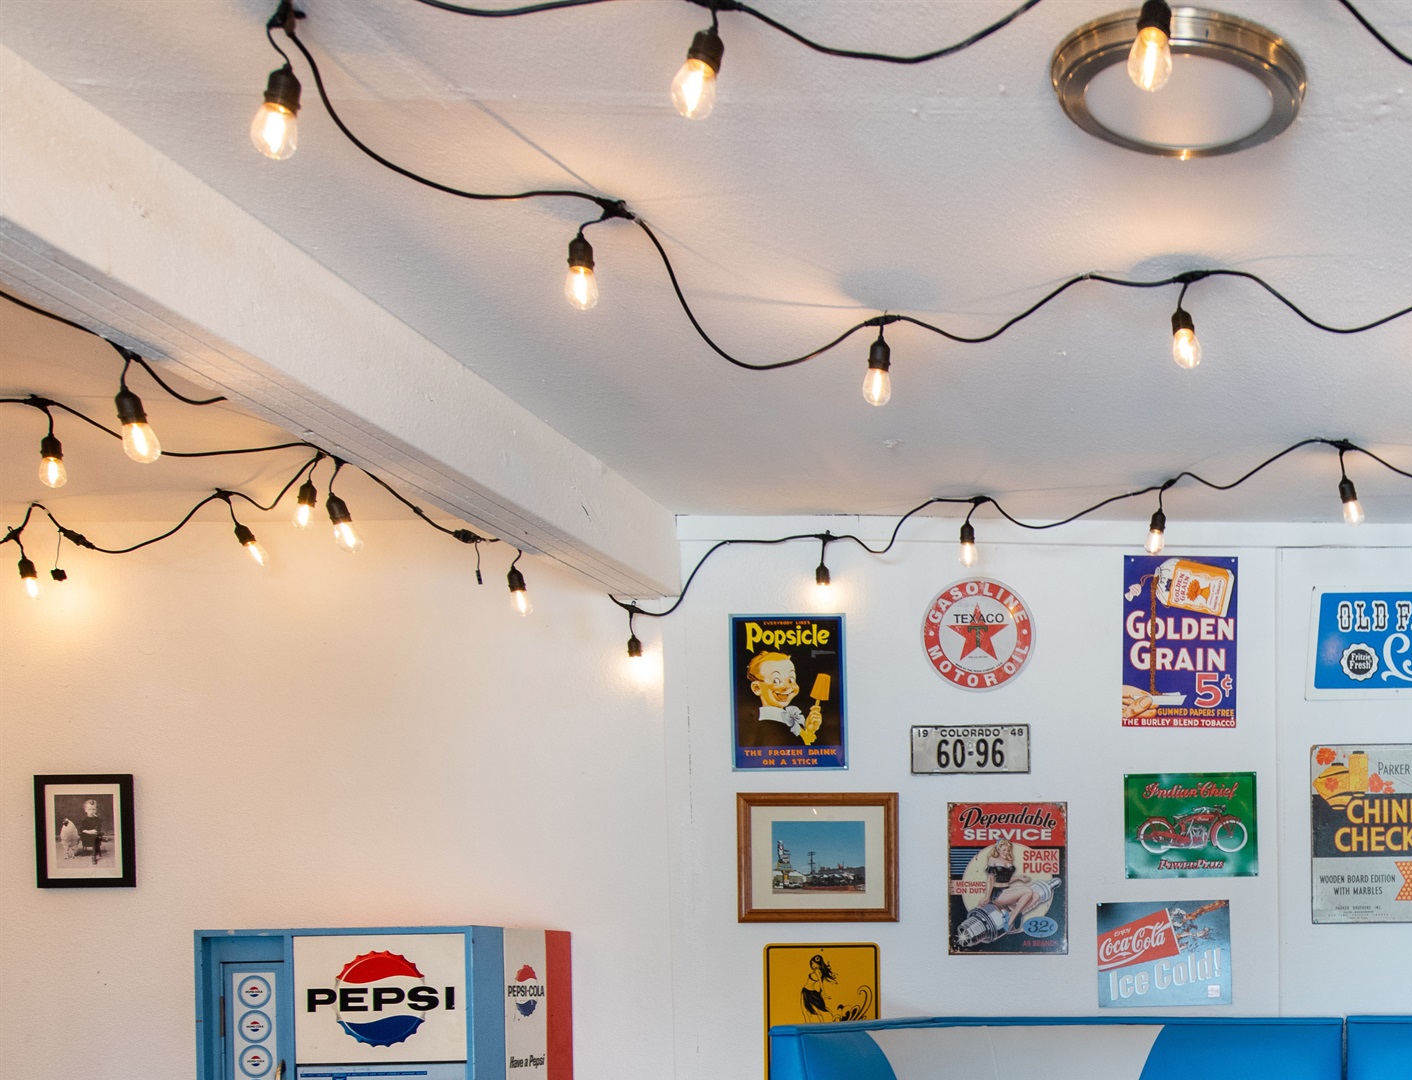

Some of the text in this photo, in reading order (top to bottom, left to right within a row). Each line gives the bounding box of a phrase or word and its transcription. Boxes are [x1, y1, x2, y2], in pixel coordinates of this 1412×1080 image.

[928, 582, 1028, 624] GASOLINE
[953, 613, 1004, 624] TEXACO
[1336, 600, 1389, 632] OLD
[1126, 610, 1235, 641] GOLDEN
[745, 622, 830, 653] Popsicle
[1130, 640, 1226, 672] GRAIN
[927, 645, 1029, 687] MOTOR OIL
[1349, 660, 1371, 670] Fresh
[1157, 708, 1234, 717] GUMMED PAPERS FREE
[1123, 718, 1235, 727] THE BURLEY BLEND TOBACCO
[917, 728, 1024, 738] 19 COLORADO 48
[808, 748, 837, 756] DRINK
[937, 738, 1005, 768] 60-96
[762, 758, 775, 766] ON
[780, 758, 787, 766] A
[1378, 761, 1410, 775] PARKER
[1142, 781, 1239, 800] Indian Chief
[959, 807, 1056, 829] Dependable
[963, 828, 1052, 841] SERVICE
[1023, 850, 1058, 862] SPARK
[1022, 862, 1059, 874] PLUGS
[1319, 874, 1396, 884] WOODEN BOARD EDITION
[1333, 886, 1383, 895] WITH MARBLES
[1114, 927, 1132, 938] Enjoy
[1099, 921, 1166, 962] Coca-Cola
[1110, 947, 1221, 1000] Ice Cold!
[508, 985, 545, 998] PEPSI-COLA
[306, 986, 456, 1012] PEPSI
[509, 1053, 546, 1069] Have a Pepsi
